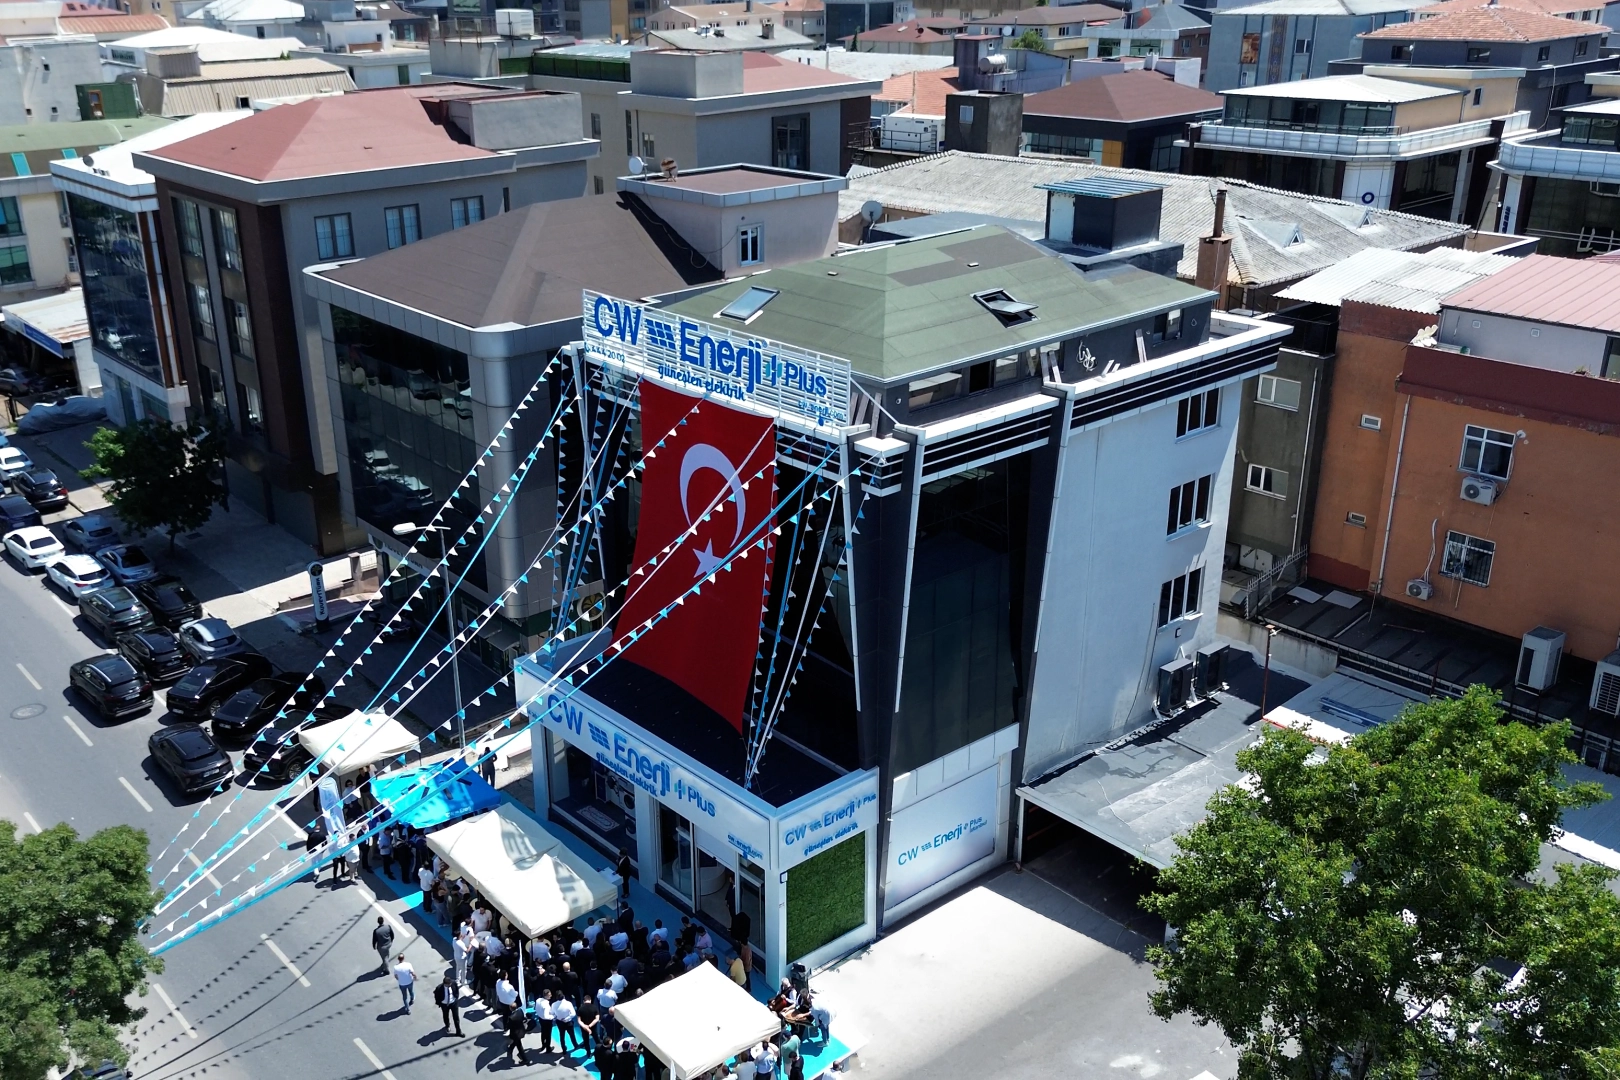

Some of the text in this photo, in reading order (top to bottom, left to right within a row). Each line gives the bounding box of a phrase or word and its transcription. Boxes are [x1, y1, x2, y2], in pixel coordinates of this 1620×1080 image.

[594, 296, 827, 397] CW Enerji Plus
[607, 350, 616, 359] 20
[705, 378, 746, 402] elektrik
[547, 694, 716, 817] CW Enerji Plus
[629, 773, 659, 798] elektrik
[784, 792, 877, 846] CW Enerji Plus
[898, 816, 983, 866] CW Enerji Plus
